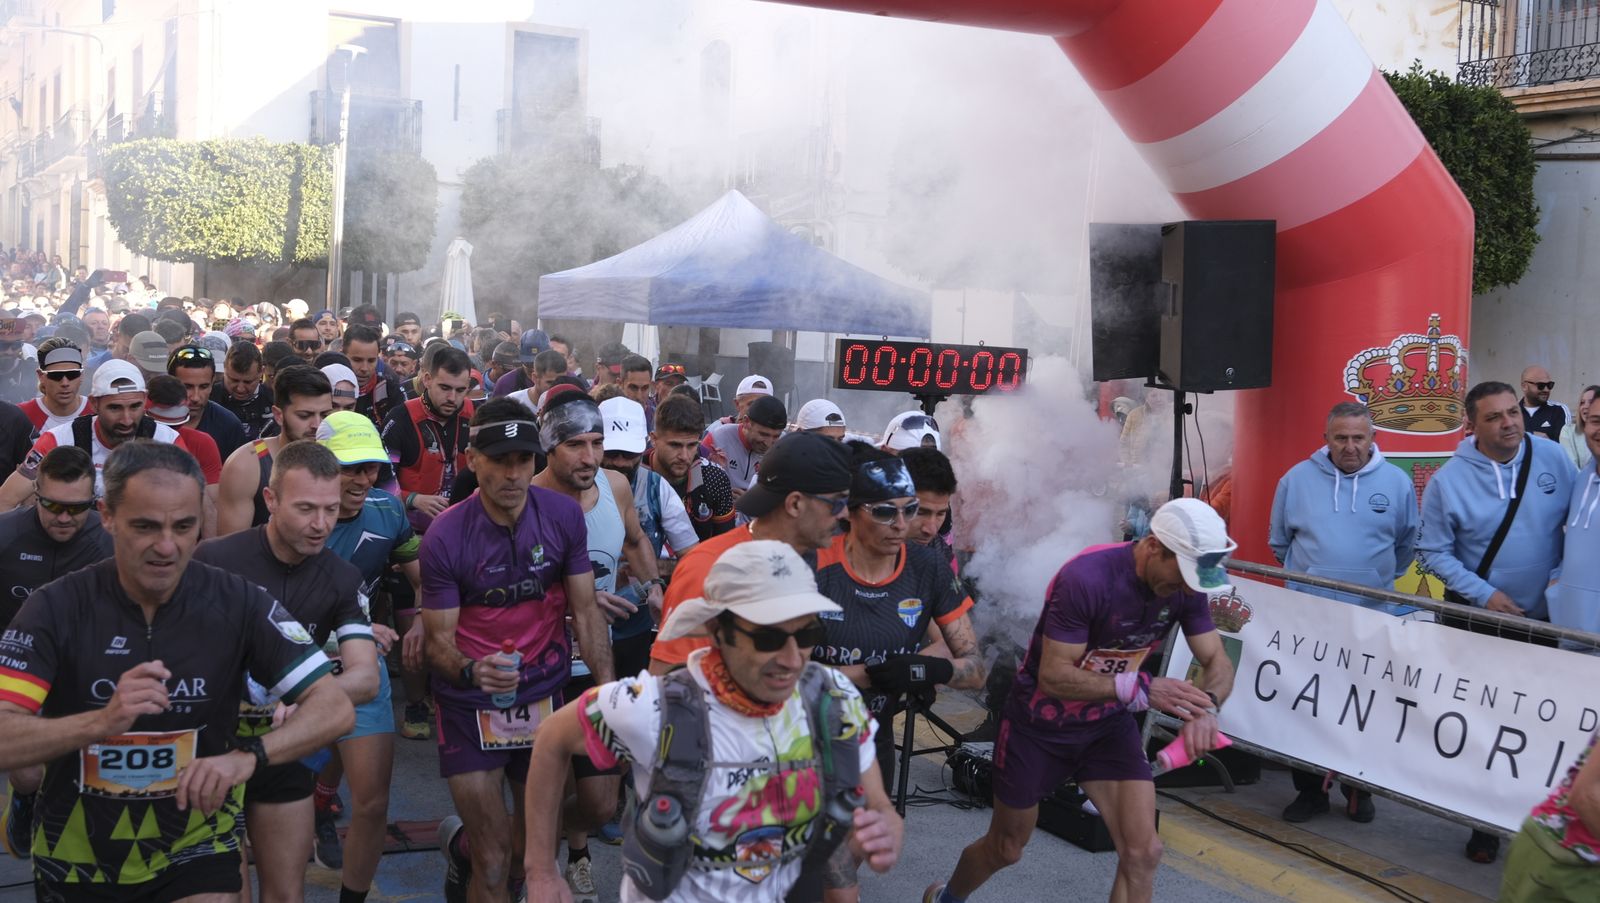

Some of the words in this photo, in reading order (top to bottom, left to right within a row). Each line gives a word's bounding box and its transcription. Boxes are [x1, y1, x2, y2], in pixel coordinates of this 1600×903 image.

[0, 655, 28, 670] TINO
[1100, 659, 1128, 674] 38
[1267, 630, 1557, 722] AYUNTAMIENTO
[1579, 707, 1599, 733] D
[501, 704, 531, 724] 14
[1254, 660, 1565, 788] CANTORI
[101, 748, 174, 770] 208
